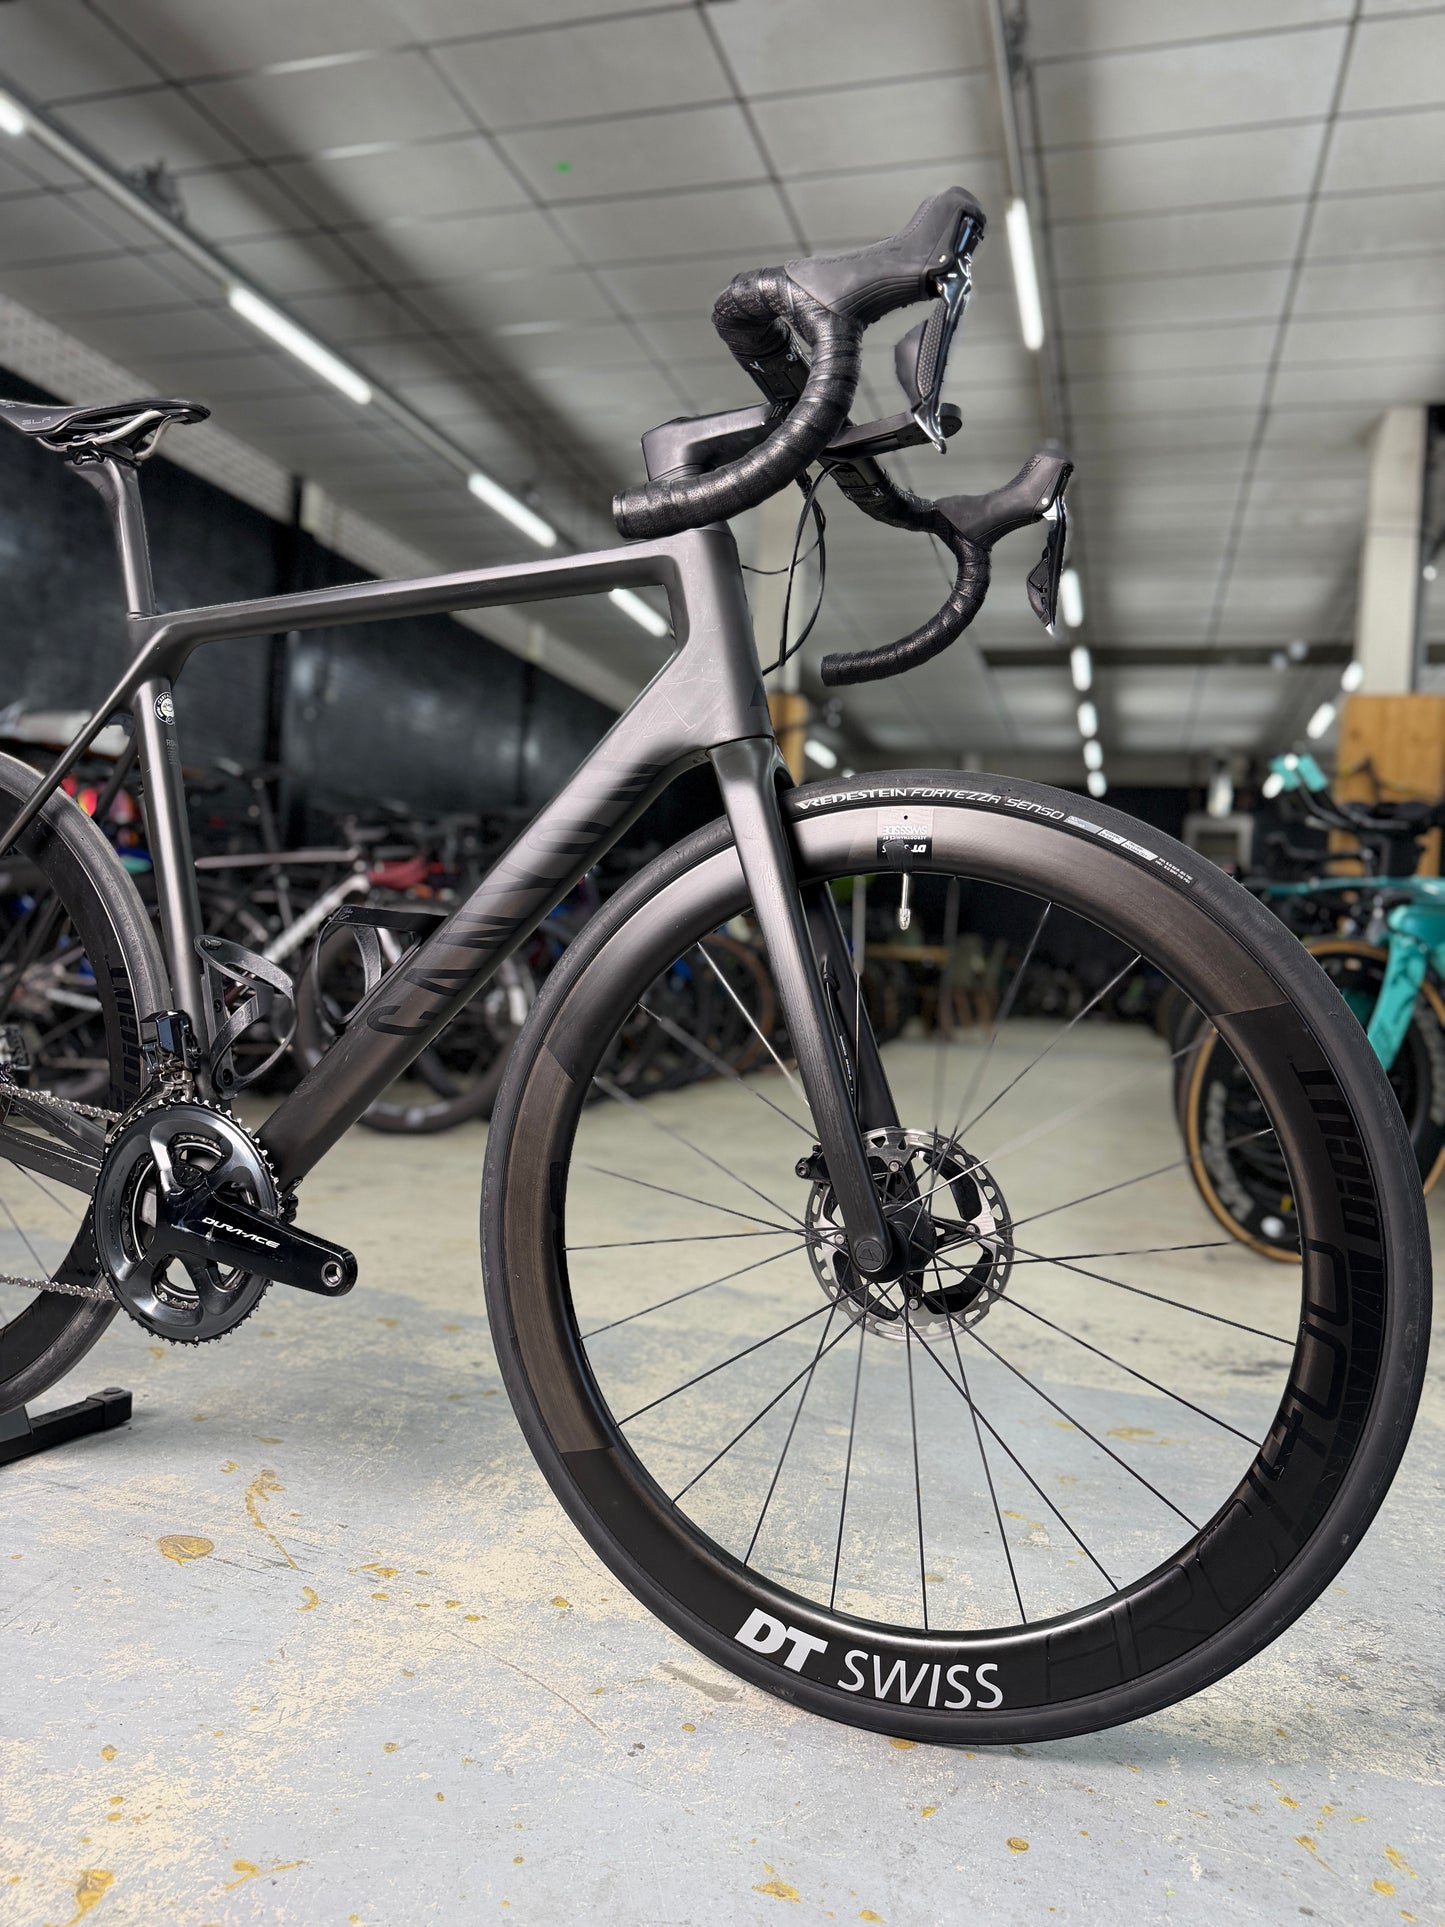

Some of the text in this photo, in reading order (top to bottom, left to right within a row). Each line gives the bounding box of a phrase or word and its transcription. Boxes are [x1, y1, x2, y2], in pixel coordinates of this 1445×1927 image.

[794, 787, 1065, 820] VREDESTEIN FORTEZZA SENSO
[366, 757, 669, 1037] CANYON
[201, 1216, 281, 1250] DURA-ACE
[734, 1607, 1004, 1710] DT SWISS
